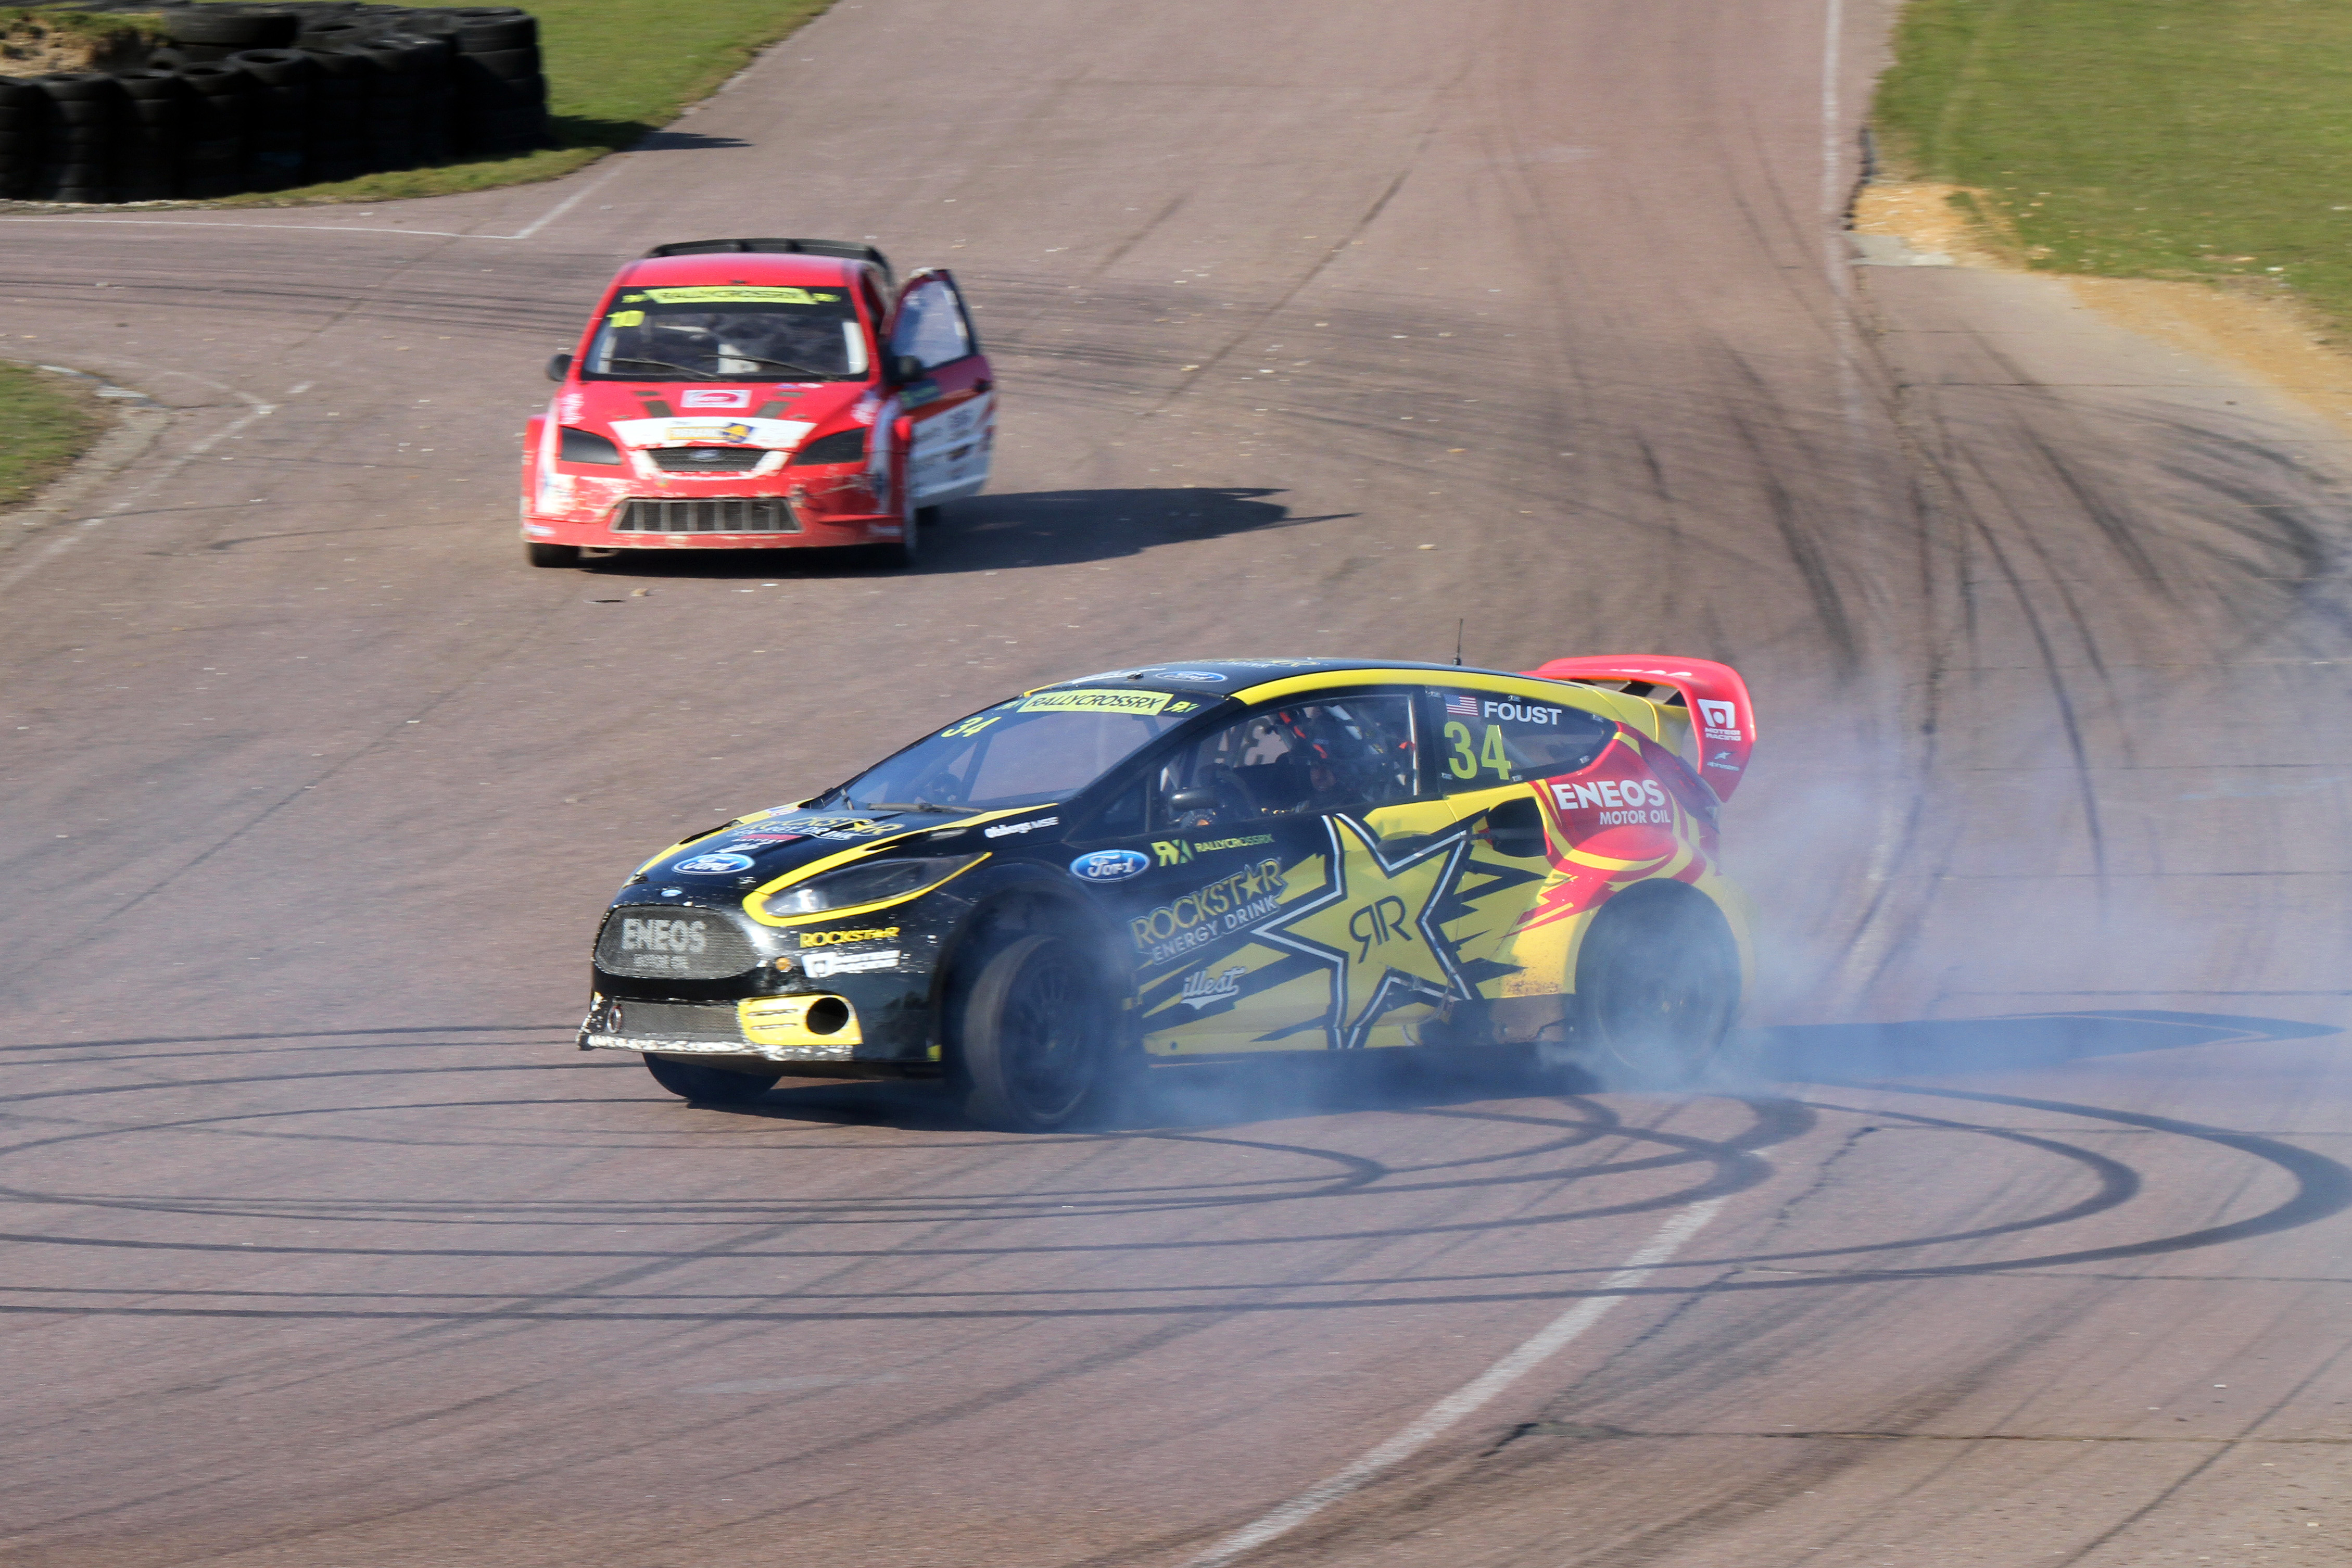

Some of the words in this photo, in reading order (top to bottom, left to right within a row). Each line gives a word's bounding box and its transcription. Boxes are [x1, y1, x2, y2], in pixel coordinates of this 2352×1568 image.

[1031, 694, 1166, 710] RALLYCROSSRX
[1484, 701, 1562, 725] FOUST
[940, 716, 1002, 738] 34
[1444, 721, 1512, 780] 34
[1550, 779, 1666, 810] ENEOS
[1599, 810, 1647, 825] MOTOR
[1650, 810, 1672, 824] OIL
[1193, 833, 1275, 853] RALLYCROSSRX
[1087, 854, 1136, 878] Ford
[622, 918, 708, 954] ENEOS
[1151, 919, 1218, 962] ENERGY
[1223, 894, 1278, 930] DRINK
[1180, 966, 1246, 1006] illest
